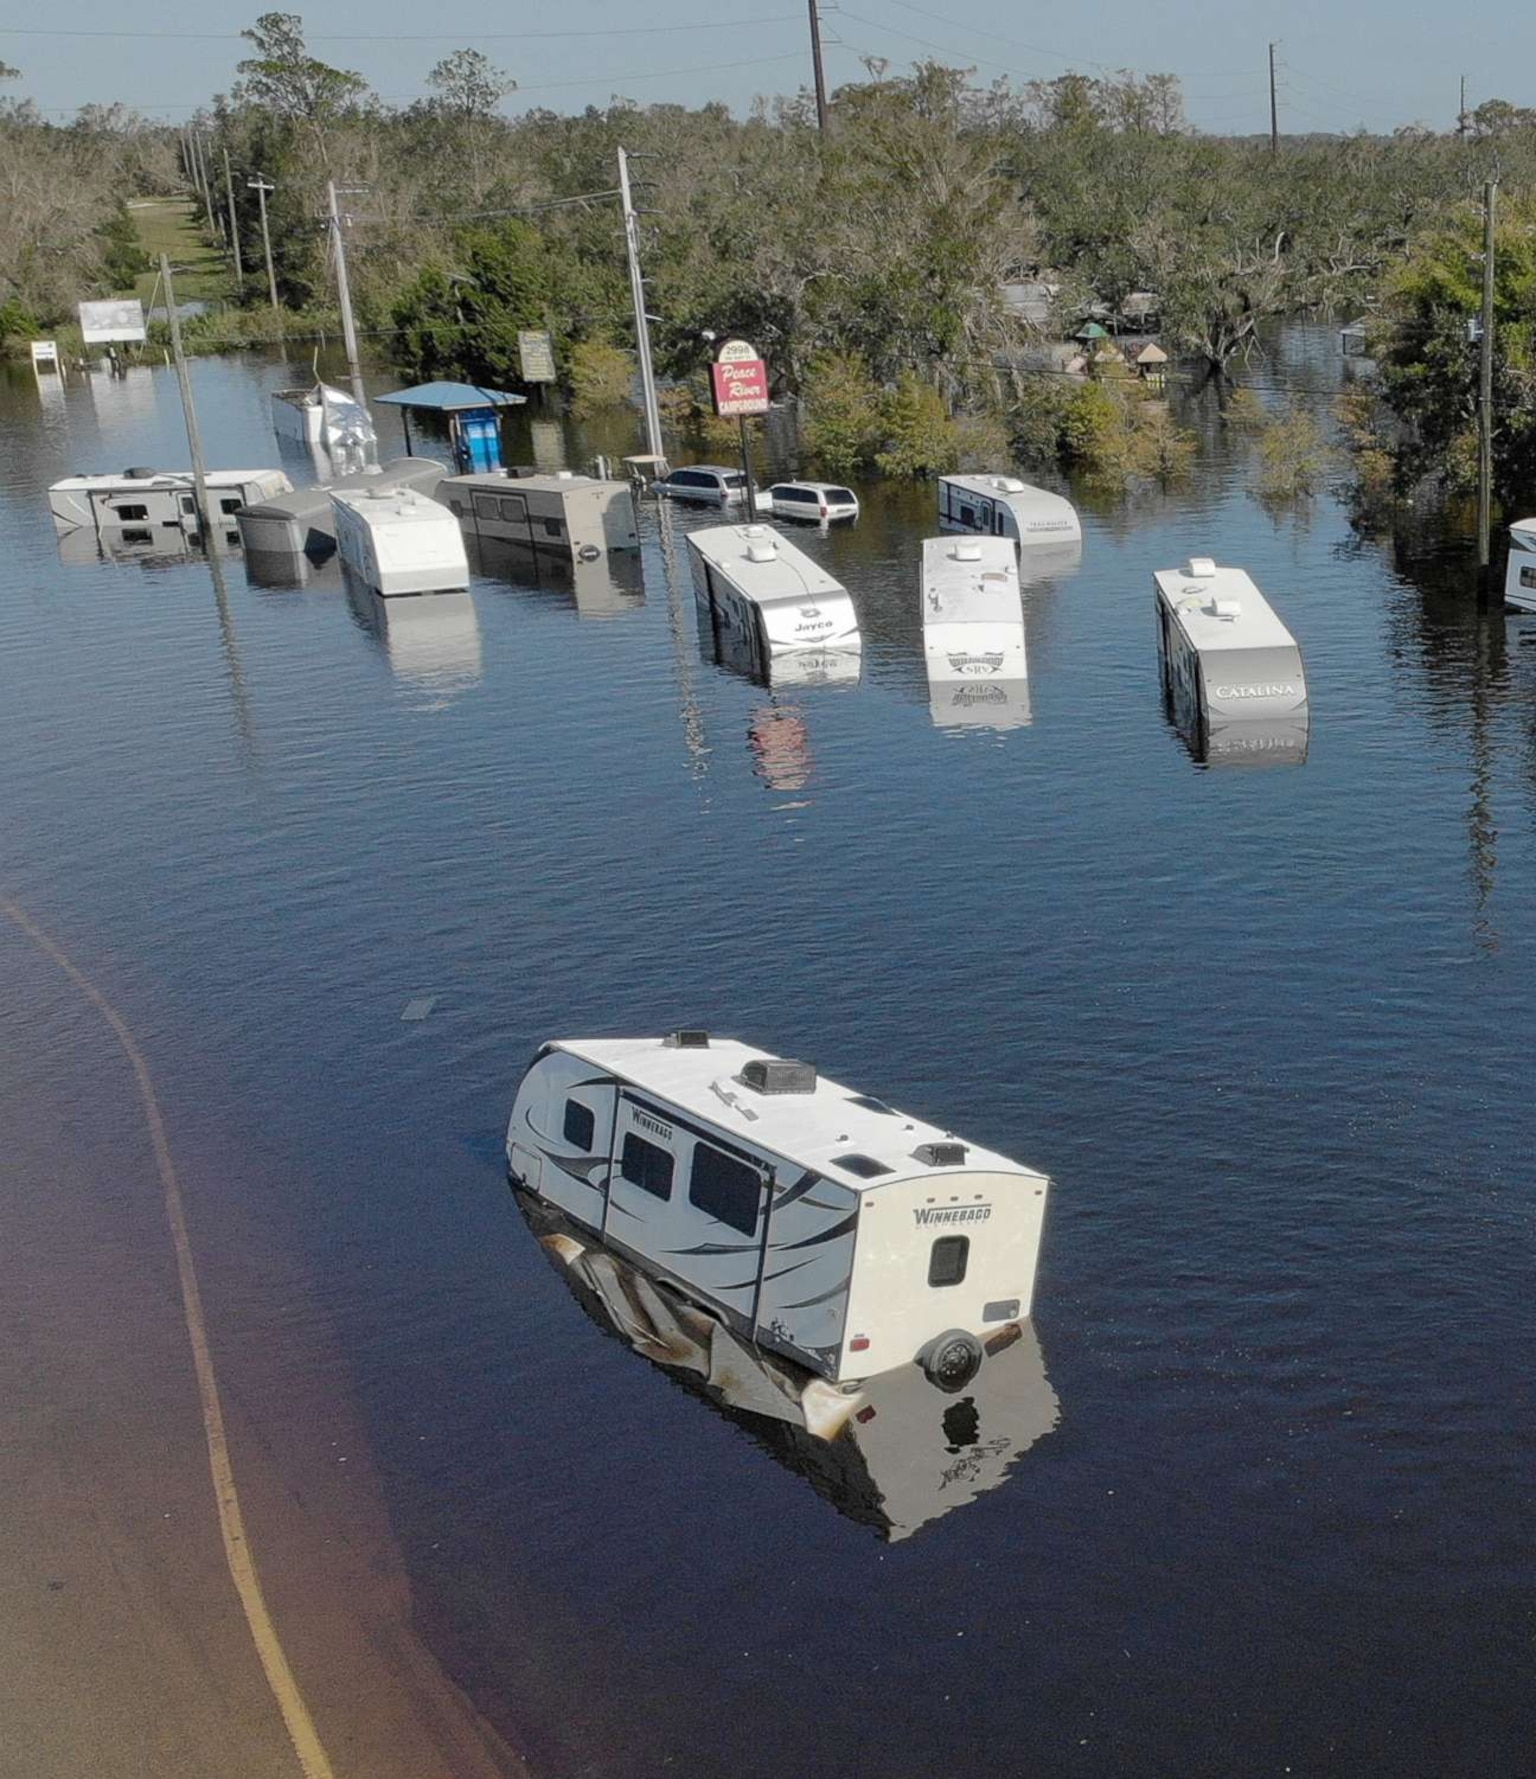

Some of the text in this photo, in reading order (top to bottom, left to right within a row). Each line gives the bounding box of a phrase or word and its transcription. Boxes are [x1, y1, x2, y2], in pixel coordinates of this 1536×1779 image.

[721, 365, 757, 383] Peace
[728, 381, 761, 398] River
[1216, 685, 1296, 699] CATALINA
[631, 1105, 673, 1140] WINNEBAGO
[912, 1204, 991, 1225] WINNEBAGO
